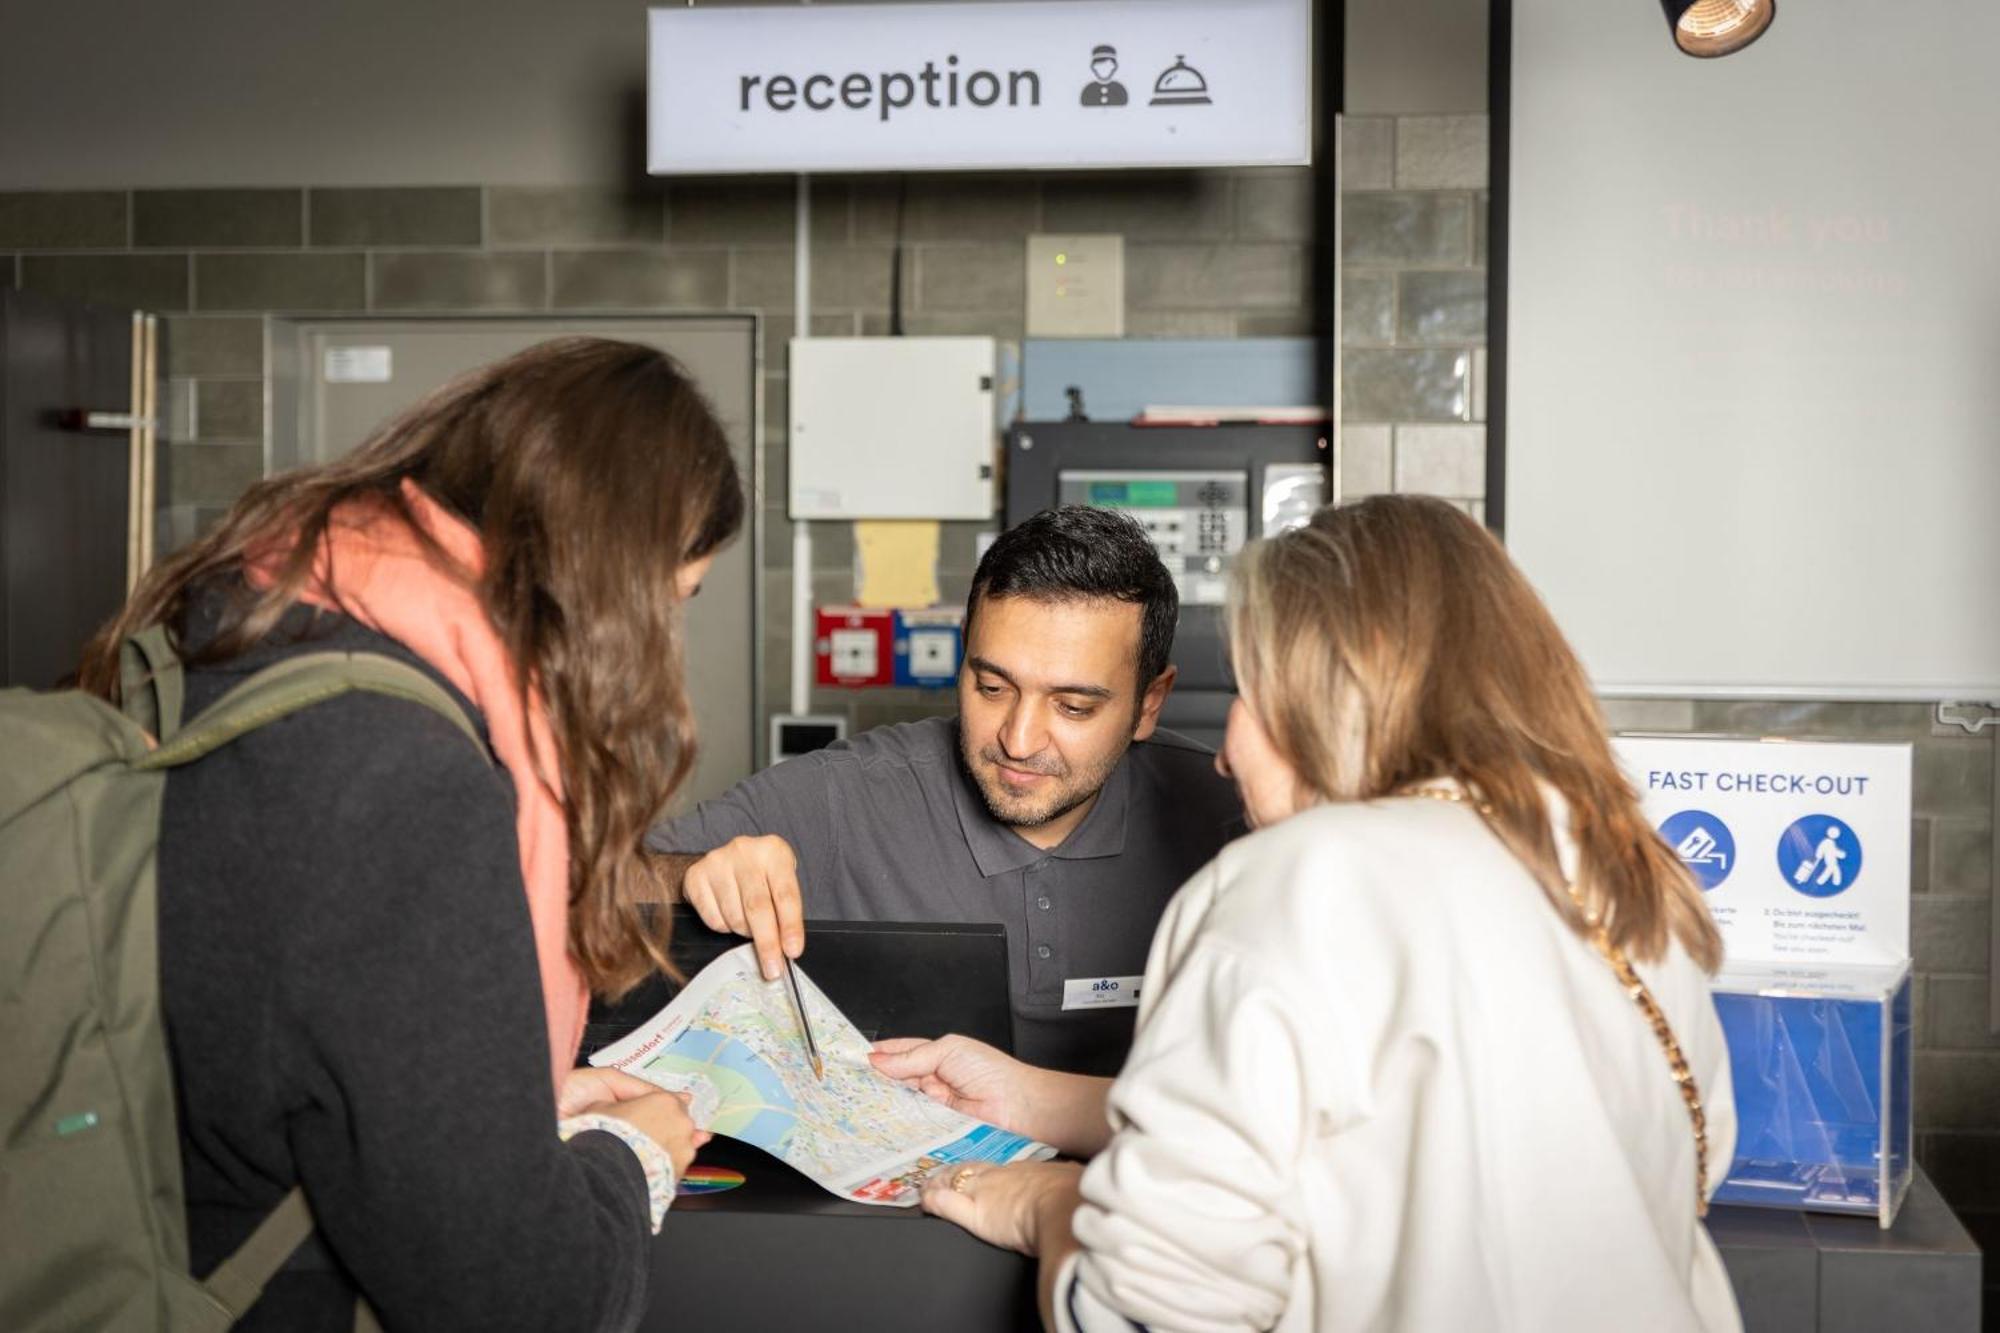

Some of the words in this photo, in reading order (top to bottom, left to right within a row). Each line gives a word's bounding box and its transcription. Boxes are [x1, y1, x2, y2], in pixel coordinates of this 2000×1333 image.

[740, 55, 1040, 121] reception
[1649, 771, 1708, 790] FAST
[1716, 773, 1868, 795] CHECK-OUT
[1092, 979, 1119, 991] a&o
